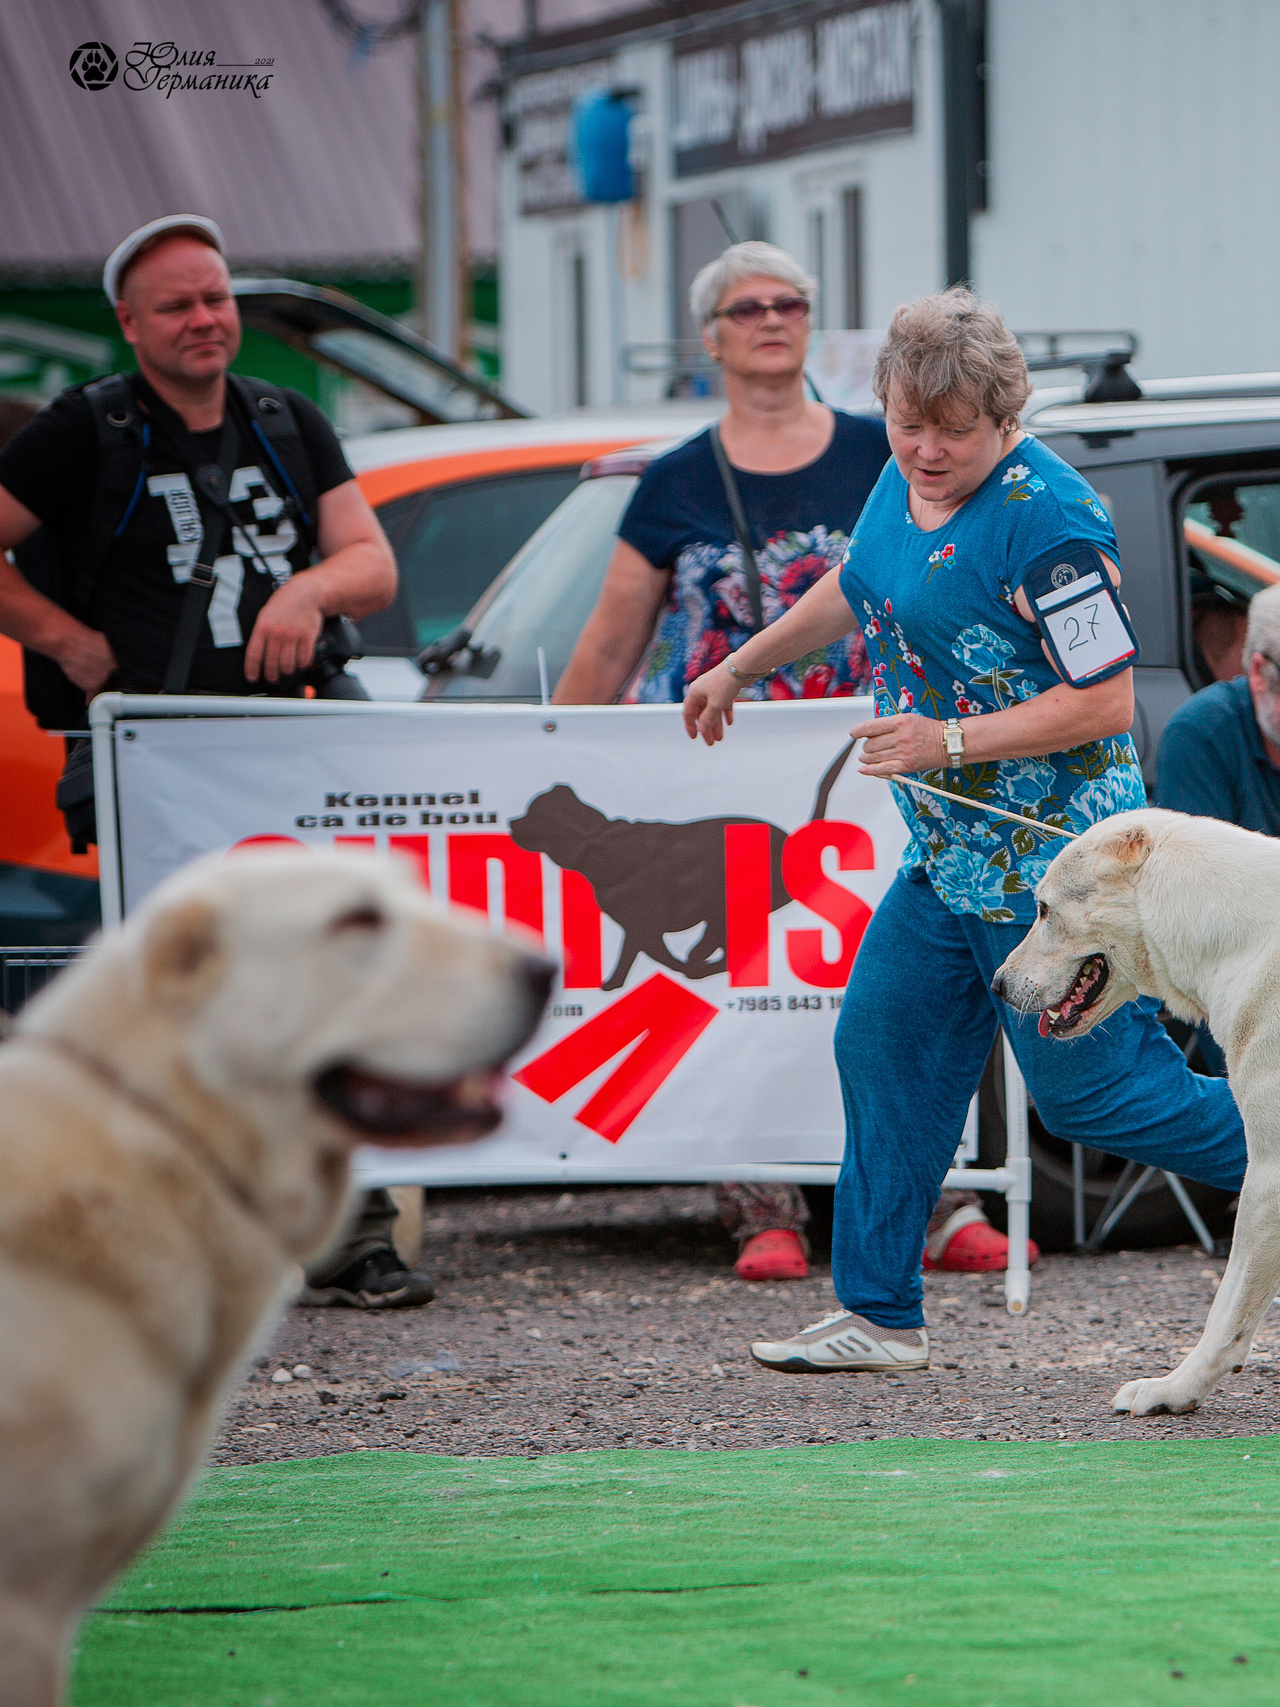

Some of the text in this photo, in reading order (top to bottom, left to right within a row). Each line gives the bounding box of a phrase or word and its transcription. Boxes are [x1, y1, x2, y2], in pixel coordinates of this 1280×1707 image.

[1063, 603, 1101, 652] 27
[325, 789, 480, 808] Kennel
[296, 809, 498, 828] ca de bou
[725, 995, 782, 1012] +7985
[788, 994, 823, 1011] 843
